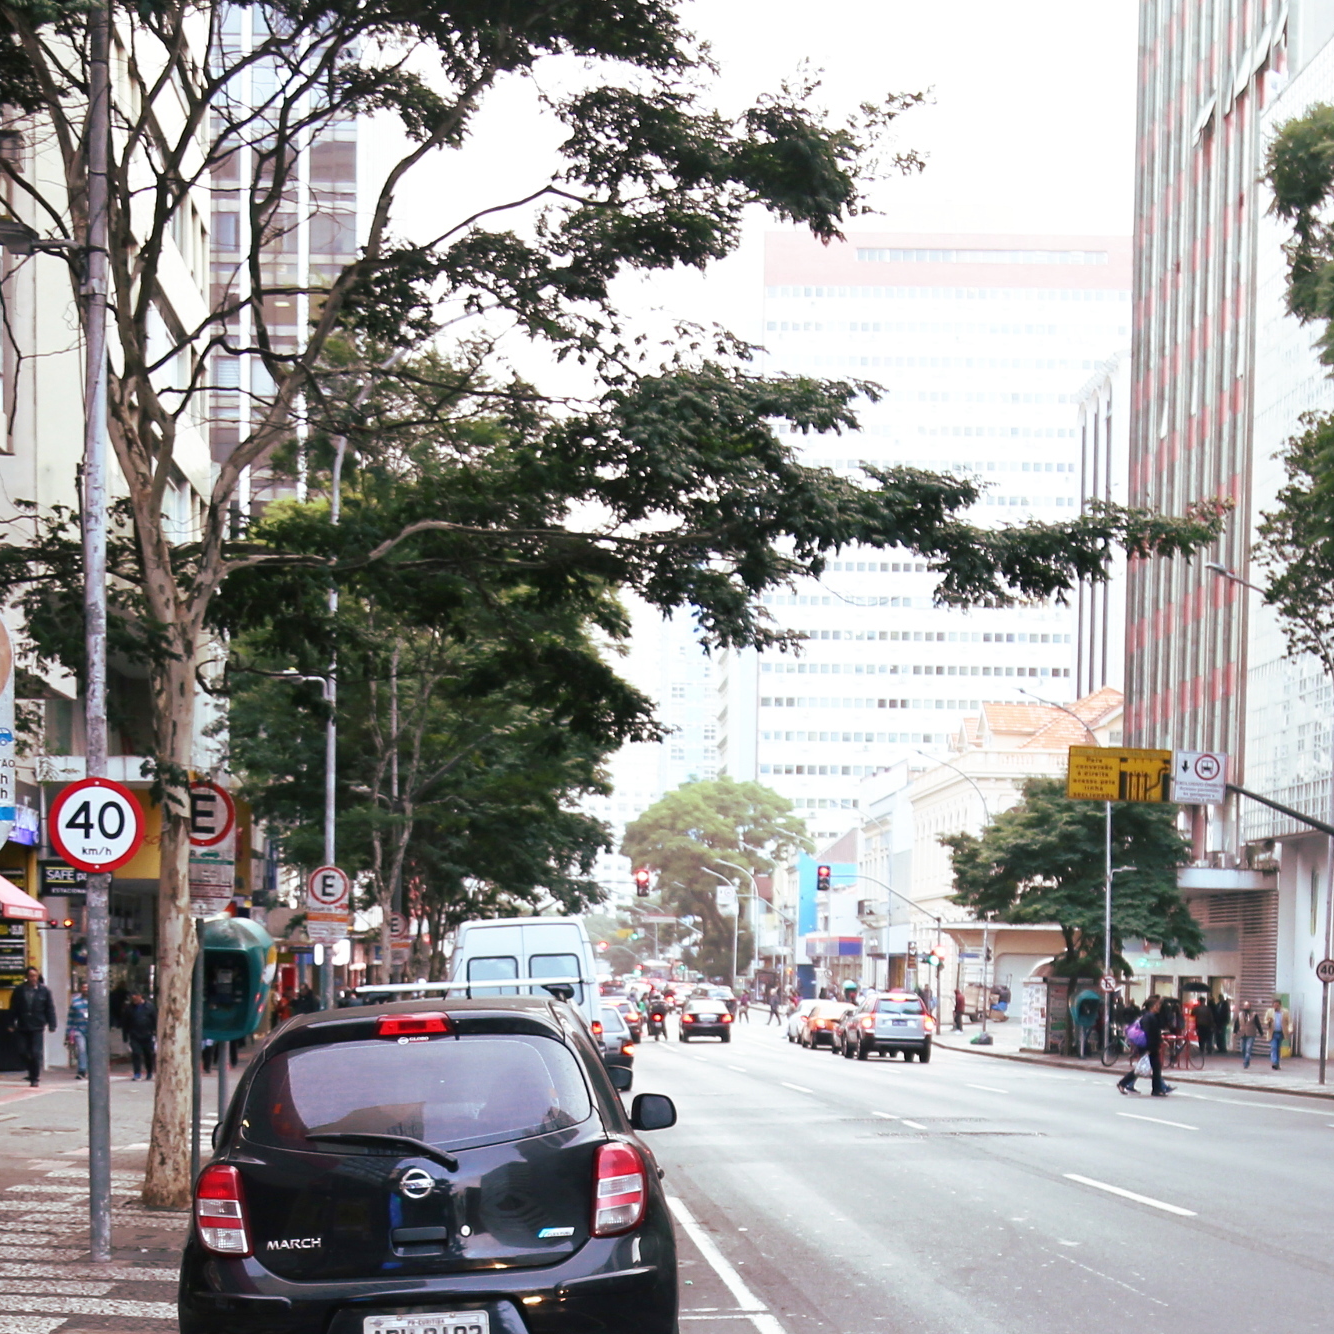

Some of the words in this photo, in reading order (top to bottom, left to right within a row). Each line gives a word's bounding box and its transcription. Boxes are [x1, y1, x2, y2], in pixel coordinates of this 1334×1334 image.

[65, 800, 125, 840] 40
[191, 793, 216, 834] E
[81, 846, 112, 856] km/h
[46, 869, 75, 881] SAFE
[321, 874, 335, 897] E
[1320, 965, 1334, 975] 40
[267, 1237, 322, 1250] MARCH
